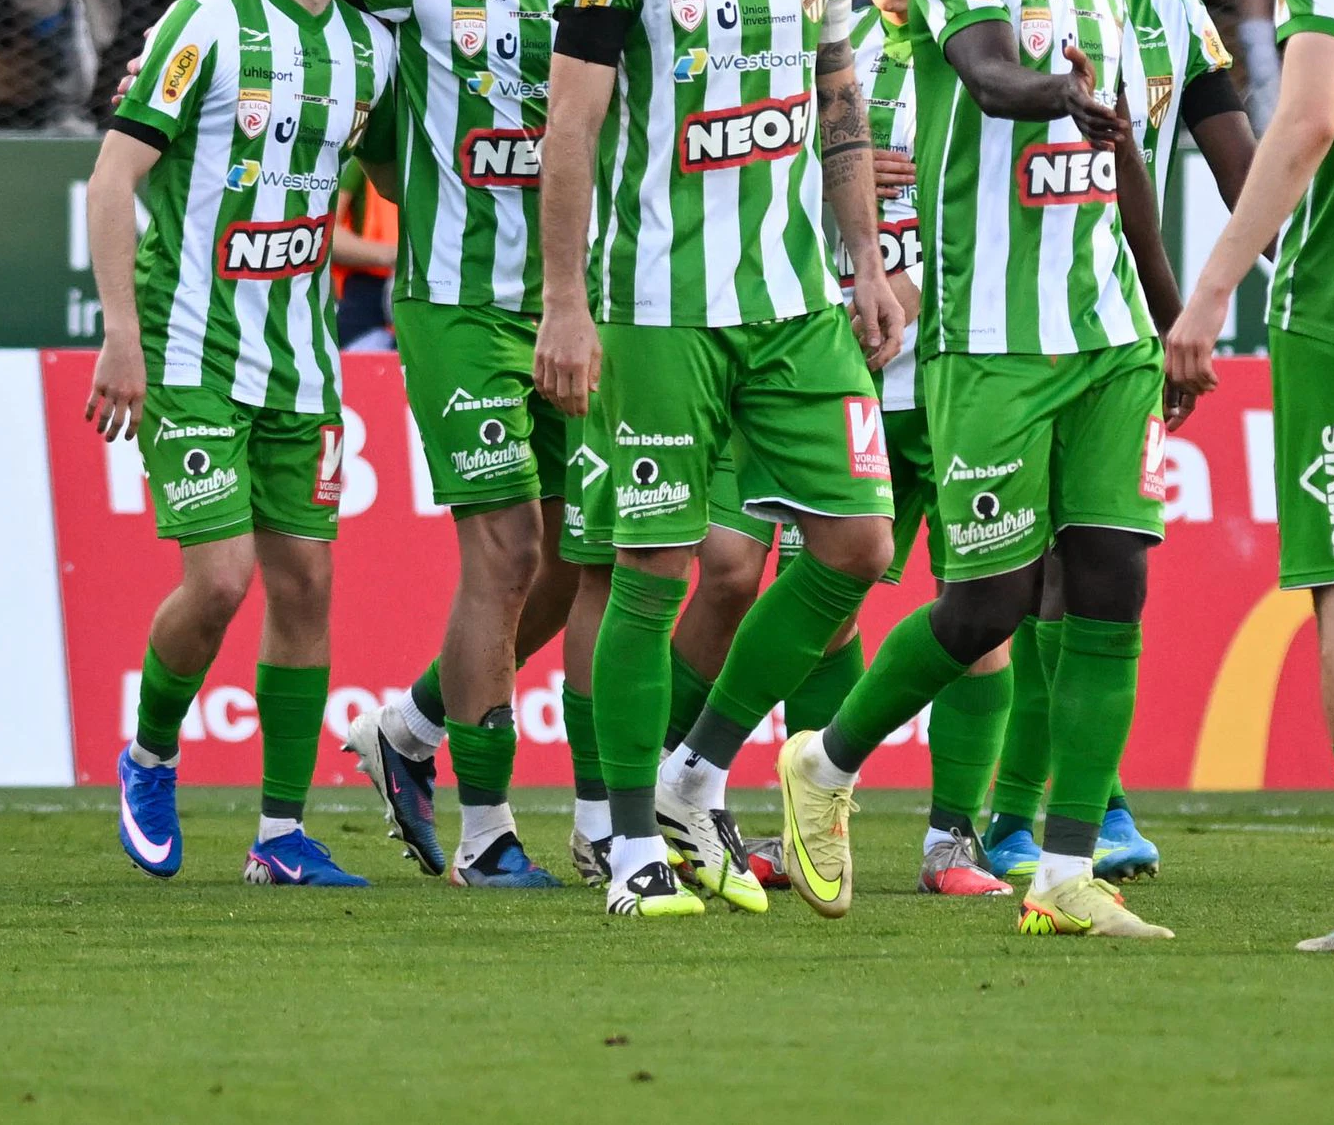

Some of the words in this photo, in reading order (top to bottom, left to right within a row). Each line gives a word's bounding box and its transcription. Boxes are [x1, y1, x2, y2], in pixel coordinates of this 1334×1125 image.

[742, 6, 769, 15] Union
[742, 14, 797, 25] Investment
[170, 50, 196, 89] RAUCH
[243, 66, 293, 83] uhlsport
[186, 425, 236, 437] bösch
[641, 433, 694, 446] bösch
[947, 507, 1036, 546] Mohrenbräu
